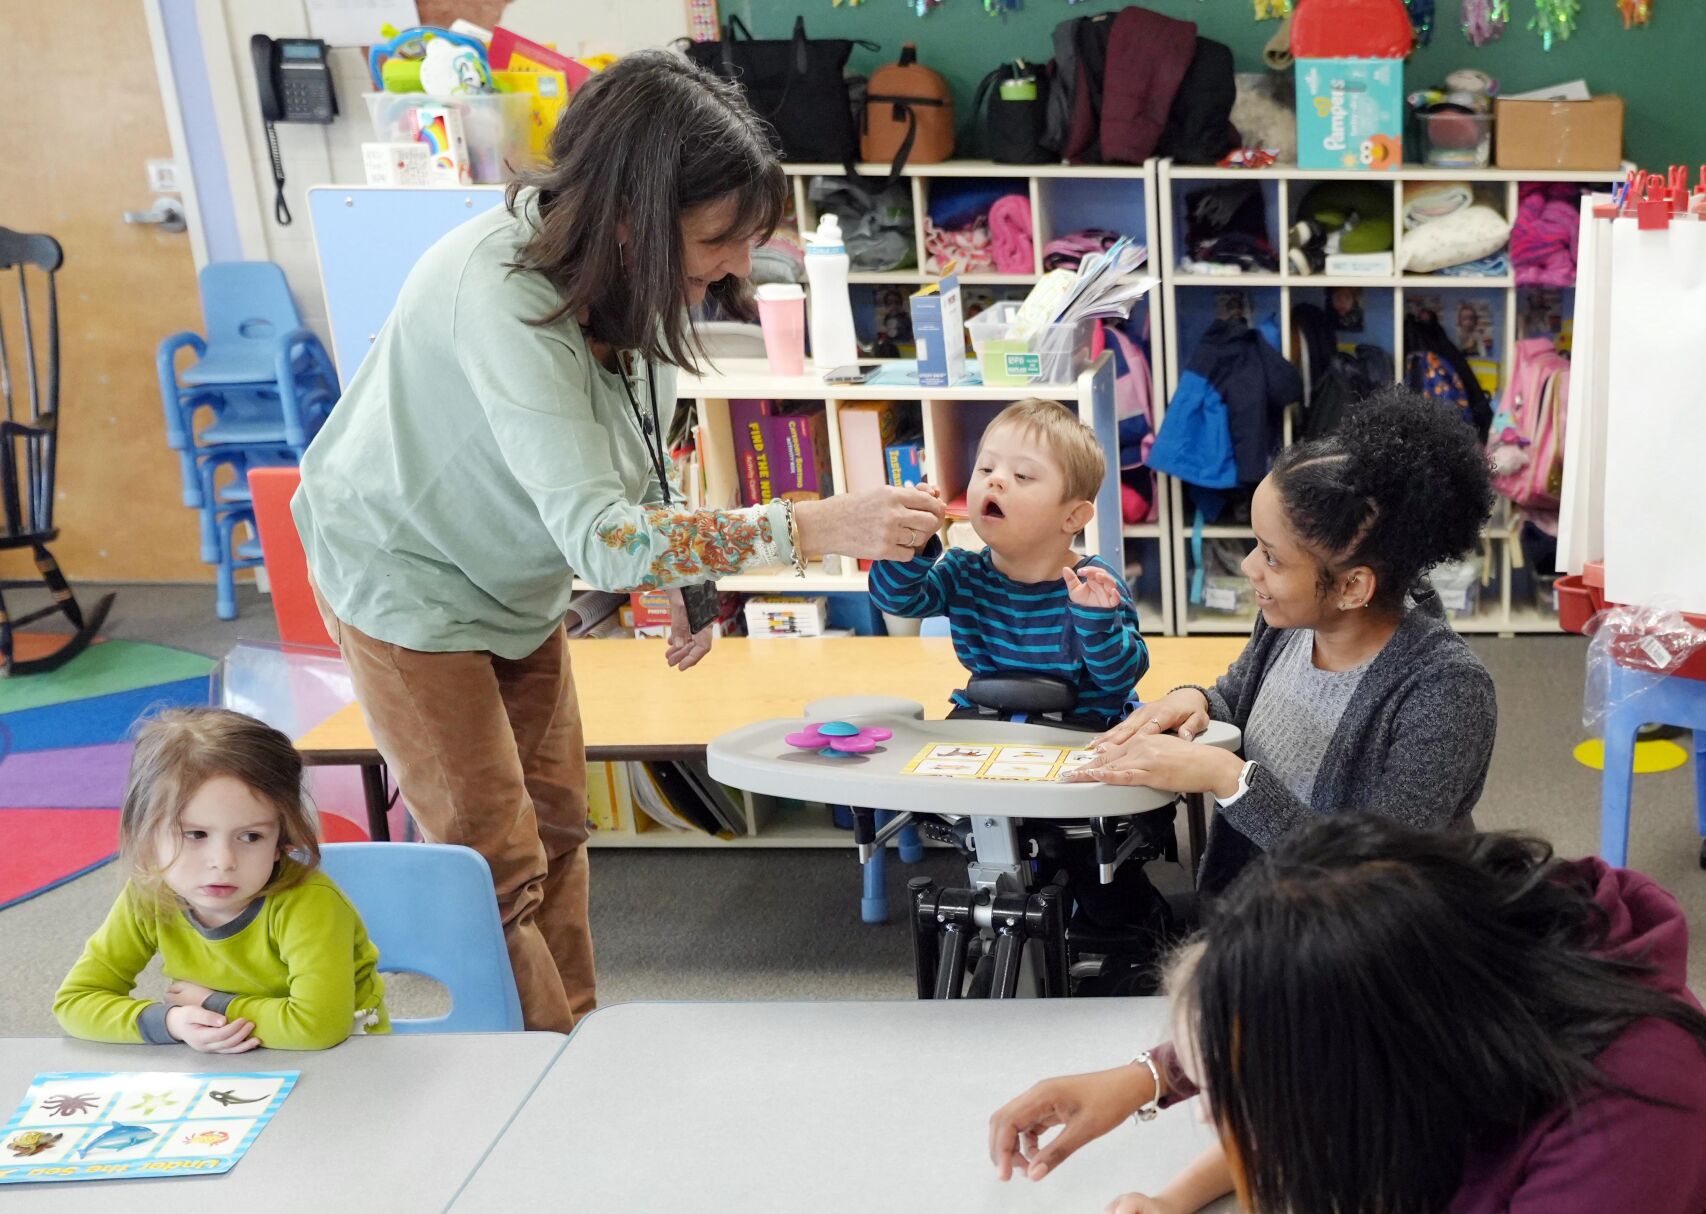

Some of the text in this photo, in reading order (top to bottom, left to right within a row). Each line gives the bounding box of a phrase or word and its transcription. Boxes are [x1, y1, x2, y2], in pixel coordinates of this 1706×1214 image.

[1323, 79, 1347, 150] Pampers
[749, 422, 764, 452] FIND
[757, 453, 770, 479] THE
[83, 1163, 131, 1174] the
[141, 1159, 220, 1171] Under
[28, 1166, 78, 1177] Sea
